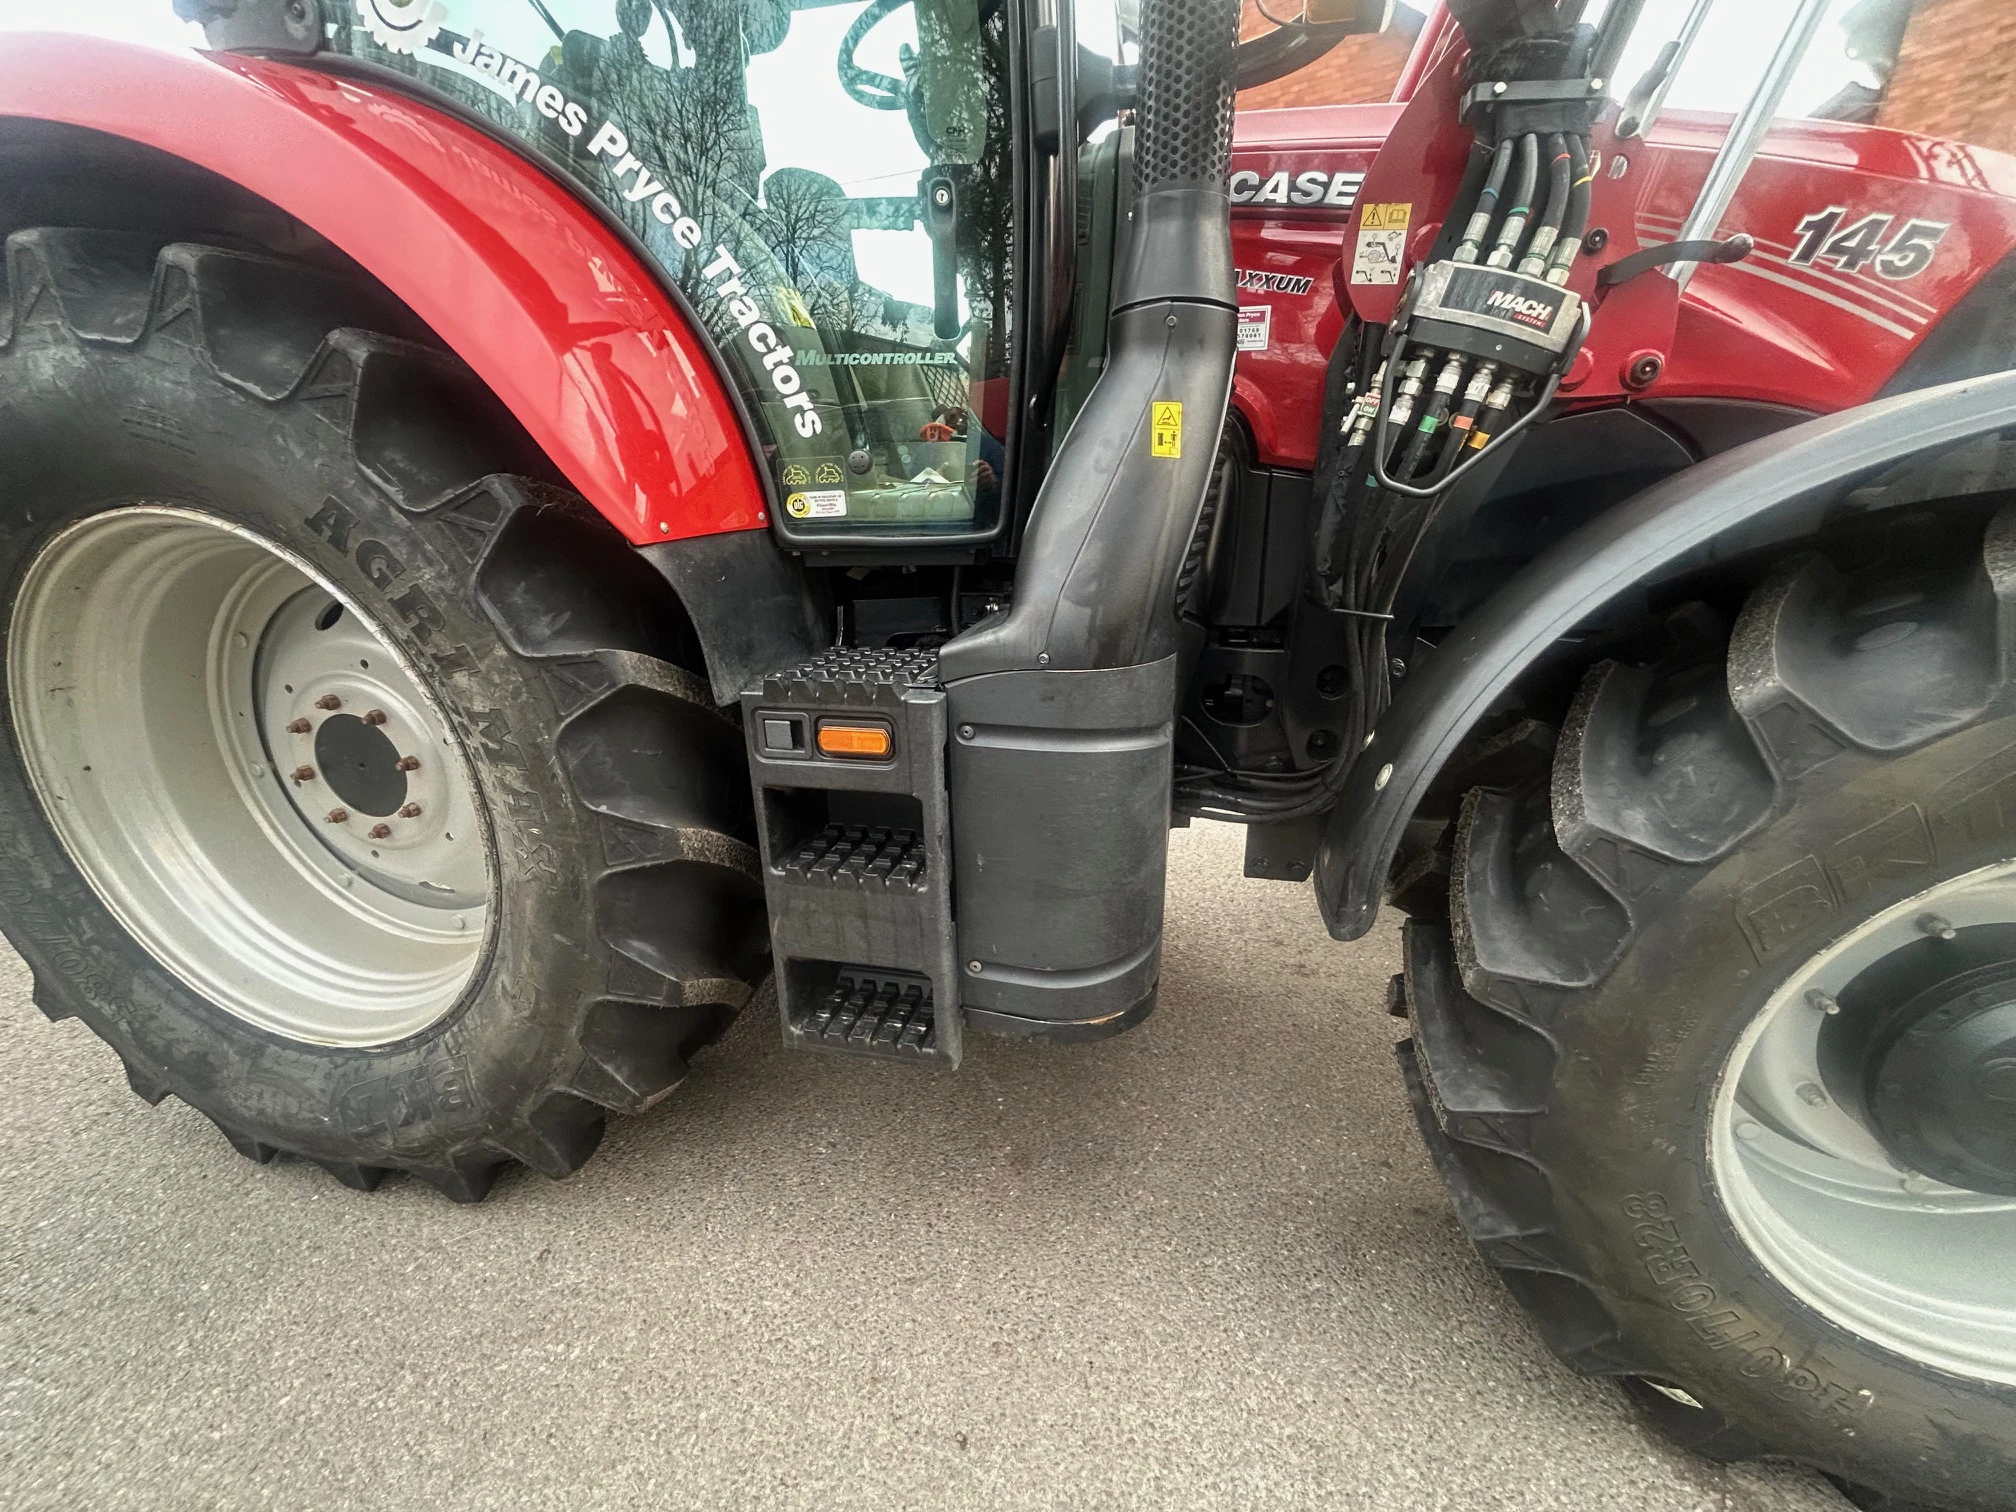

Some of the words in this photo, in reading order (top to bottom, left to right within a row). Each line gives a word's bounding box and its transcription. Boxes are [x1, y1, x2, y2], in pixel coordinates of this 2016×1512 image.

[1230, 170, 1366, 206] CASE
[453, 27, 588, 137] James
[588, 121, 702, 250] Pryce
[702, 245, 823, 440] Tractors
[1787, 205, 1951, 280] 145
[1486, 290, 1553, 321] MACH
[1517, 314, 1543, 327] SYSTEM
[1363, 405, 1375, 413] ON
[1365, 396, 1381, 406] OFF
